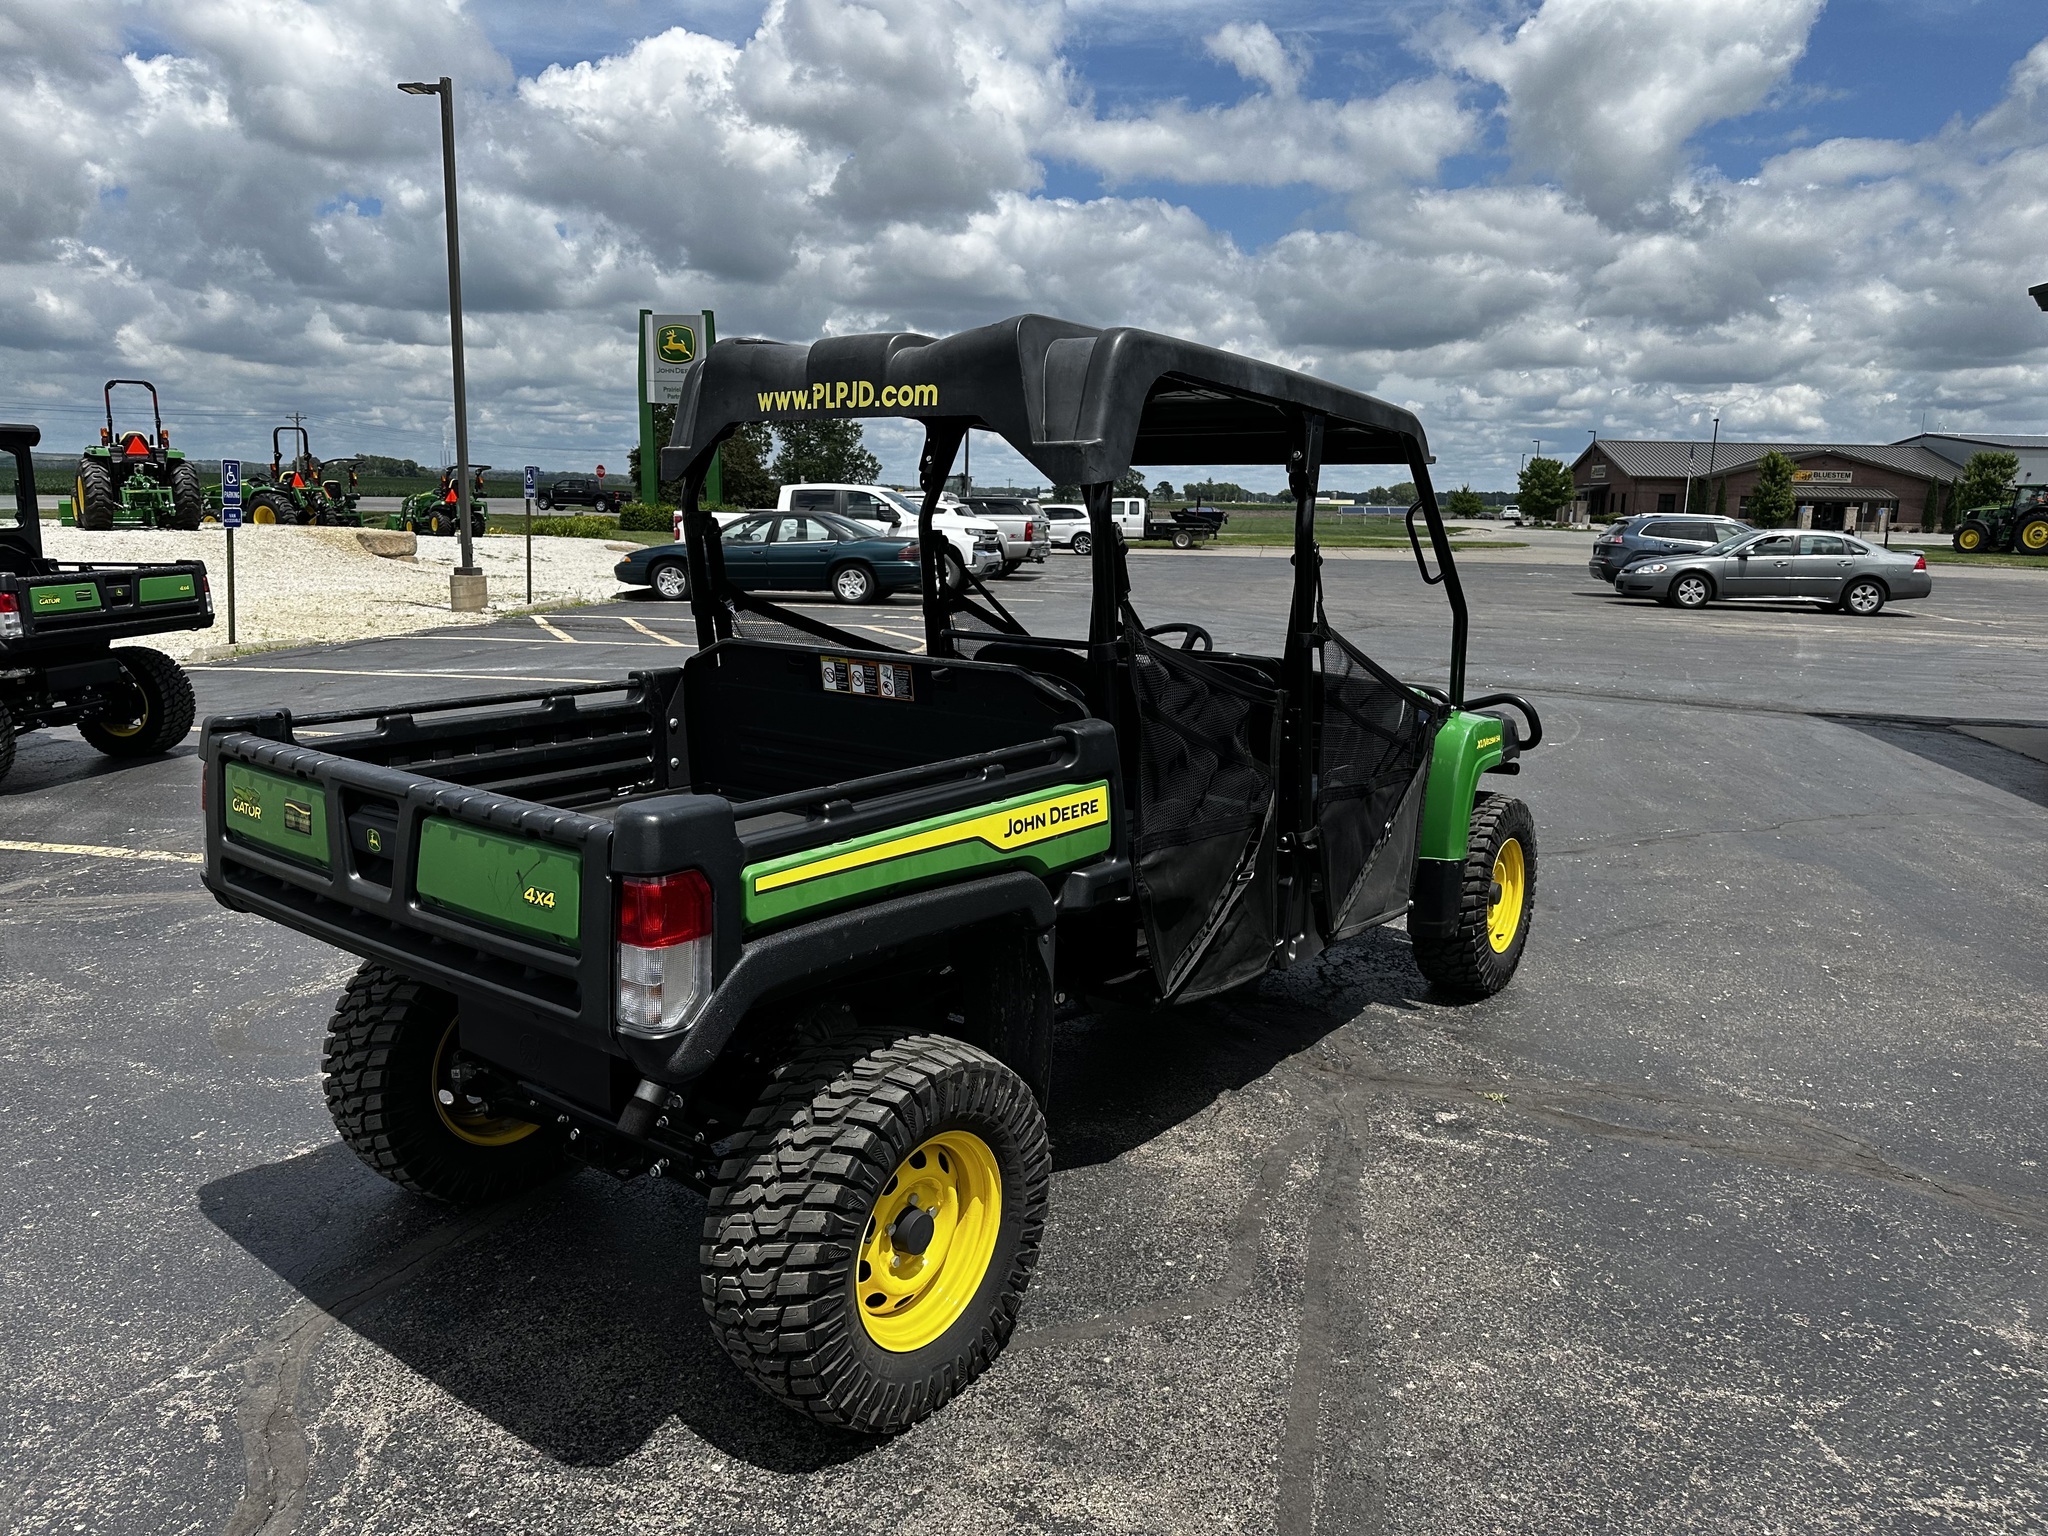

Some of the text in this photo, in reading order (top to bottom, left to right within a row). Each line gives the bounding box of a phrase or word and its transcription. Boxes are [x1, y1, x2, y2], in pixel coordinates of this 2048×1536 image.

[757, 380, 938, 412] www.PLPJD.com
[1813, 471, 1851, 479] BLUESTEM
[224, 491, 240, 499] PARKING
[232, 798, 262, 820] GATOR
[1003, 798, 1099, 838] JOHN DEERE
